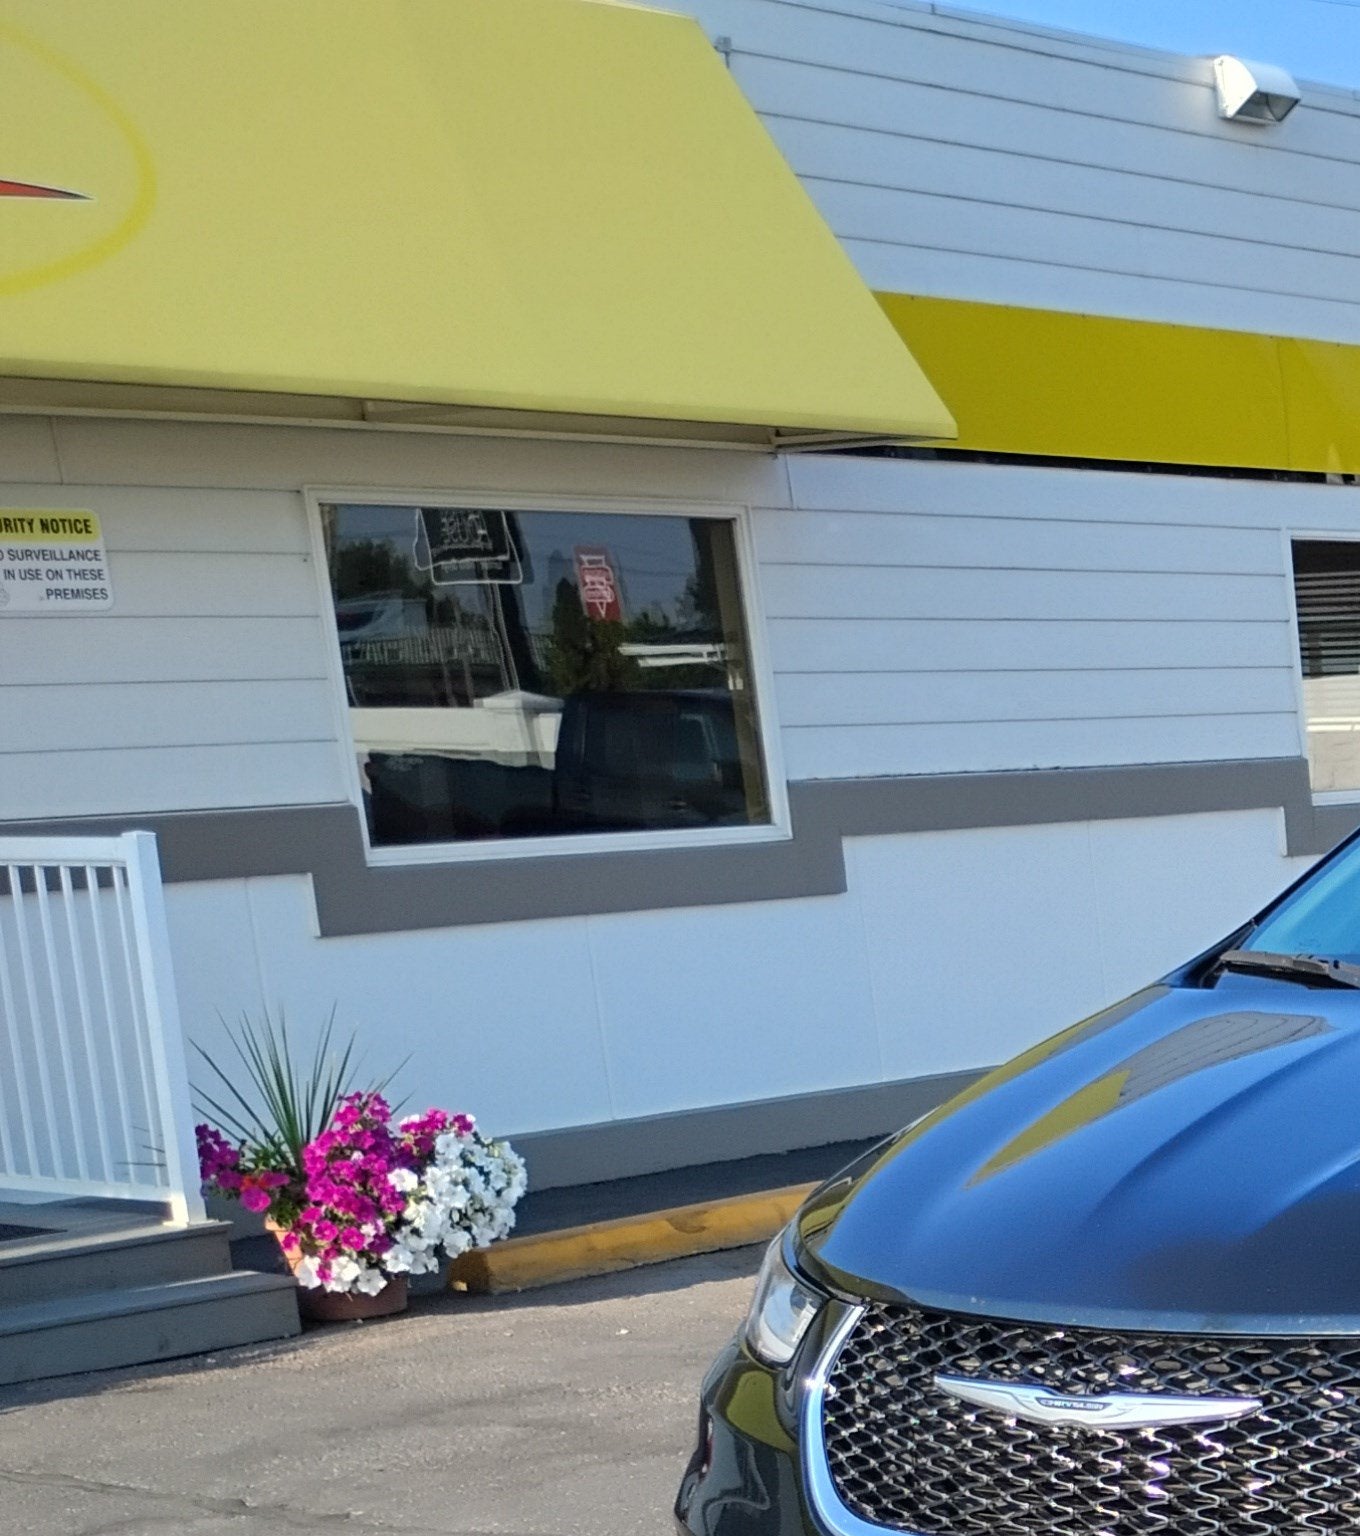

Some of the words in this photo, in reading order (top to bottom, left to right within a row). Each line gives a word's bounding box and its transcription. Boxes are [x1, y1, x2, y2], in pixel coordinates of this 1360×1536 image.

[40, 518, 92, 534] NOTICE
[8, 549, 102, 562] SURVEILLANCE
[4, 569, 15, 581] IN
[19, 569, 42, 581] USE
[46, 569, 63, 581] ON
[67, 569, 105, 581] THESE
[46, 588, 108, 600] PREMISES
